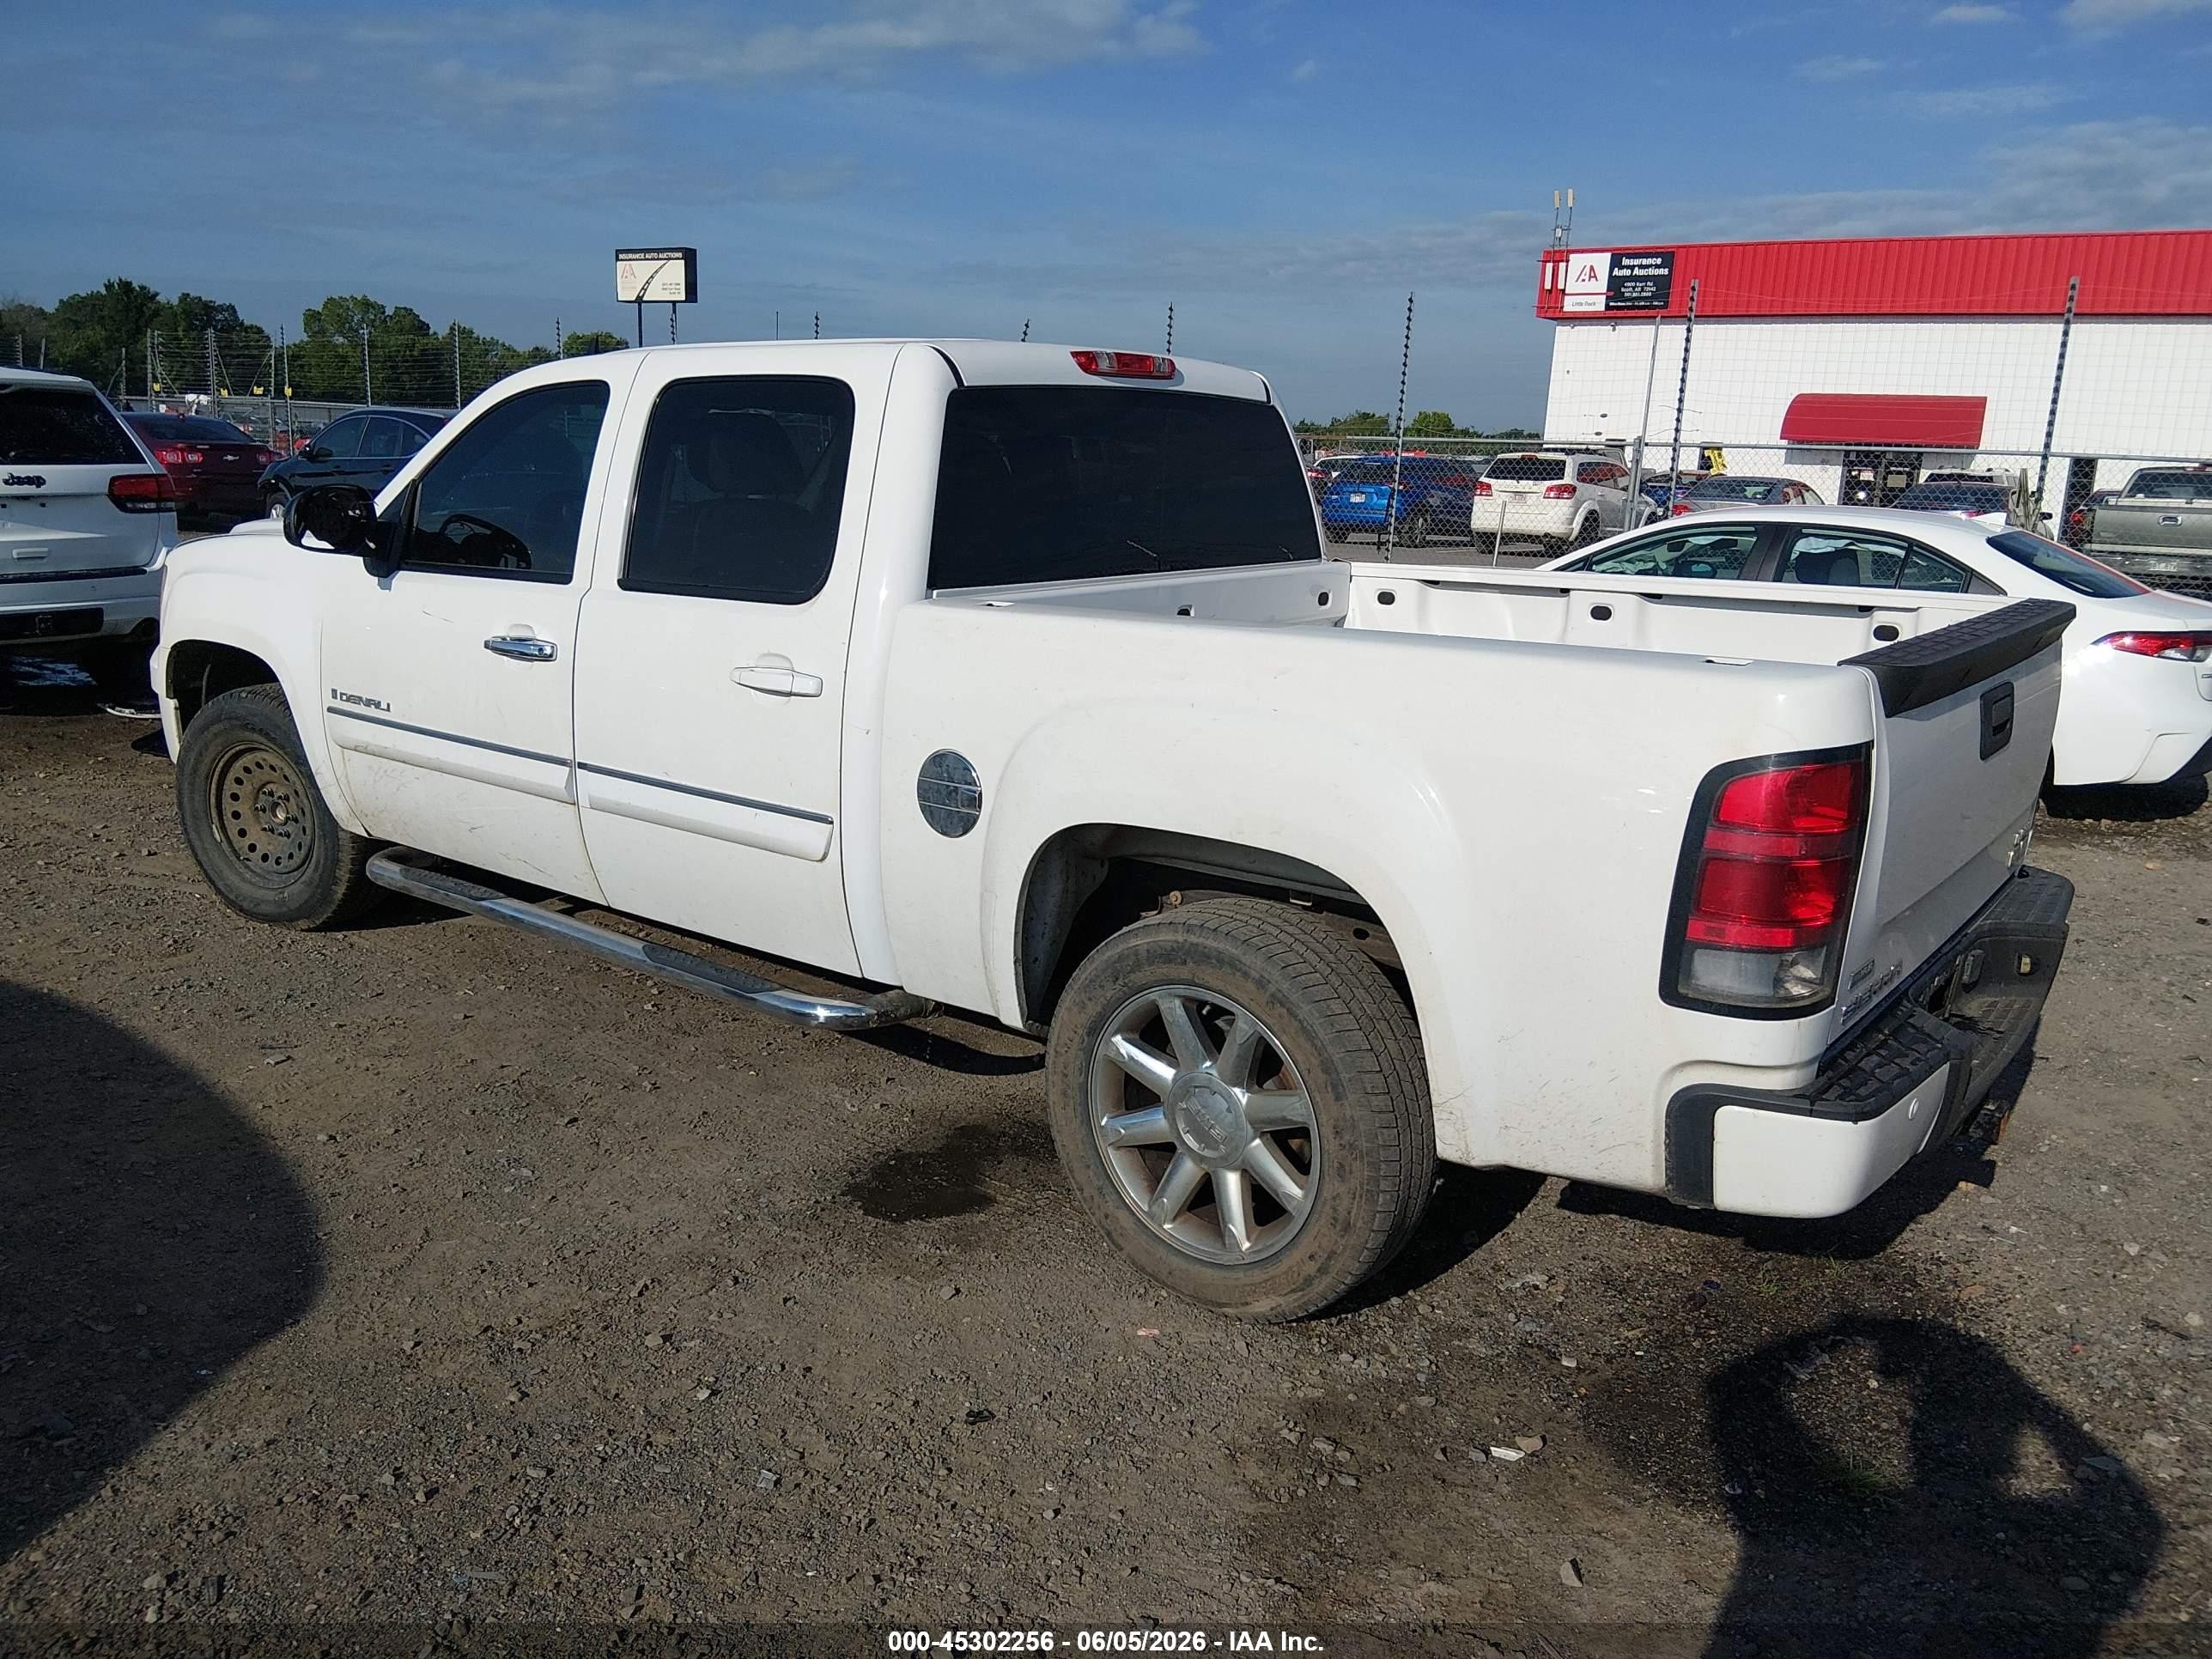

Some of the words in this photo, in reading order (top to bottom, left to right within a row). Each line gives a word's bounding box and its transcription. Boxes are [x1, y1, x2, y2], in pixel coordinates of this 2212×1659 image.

[1622, 257, 1662, 265] Insurance
[1632, 266, 1668, 276] Auctions
[3, 472, 46, 489] Jeep
[339, 691, 392, 713] DENALI
